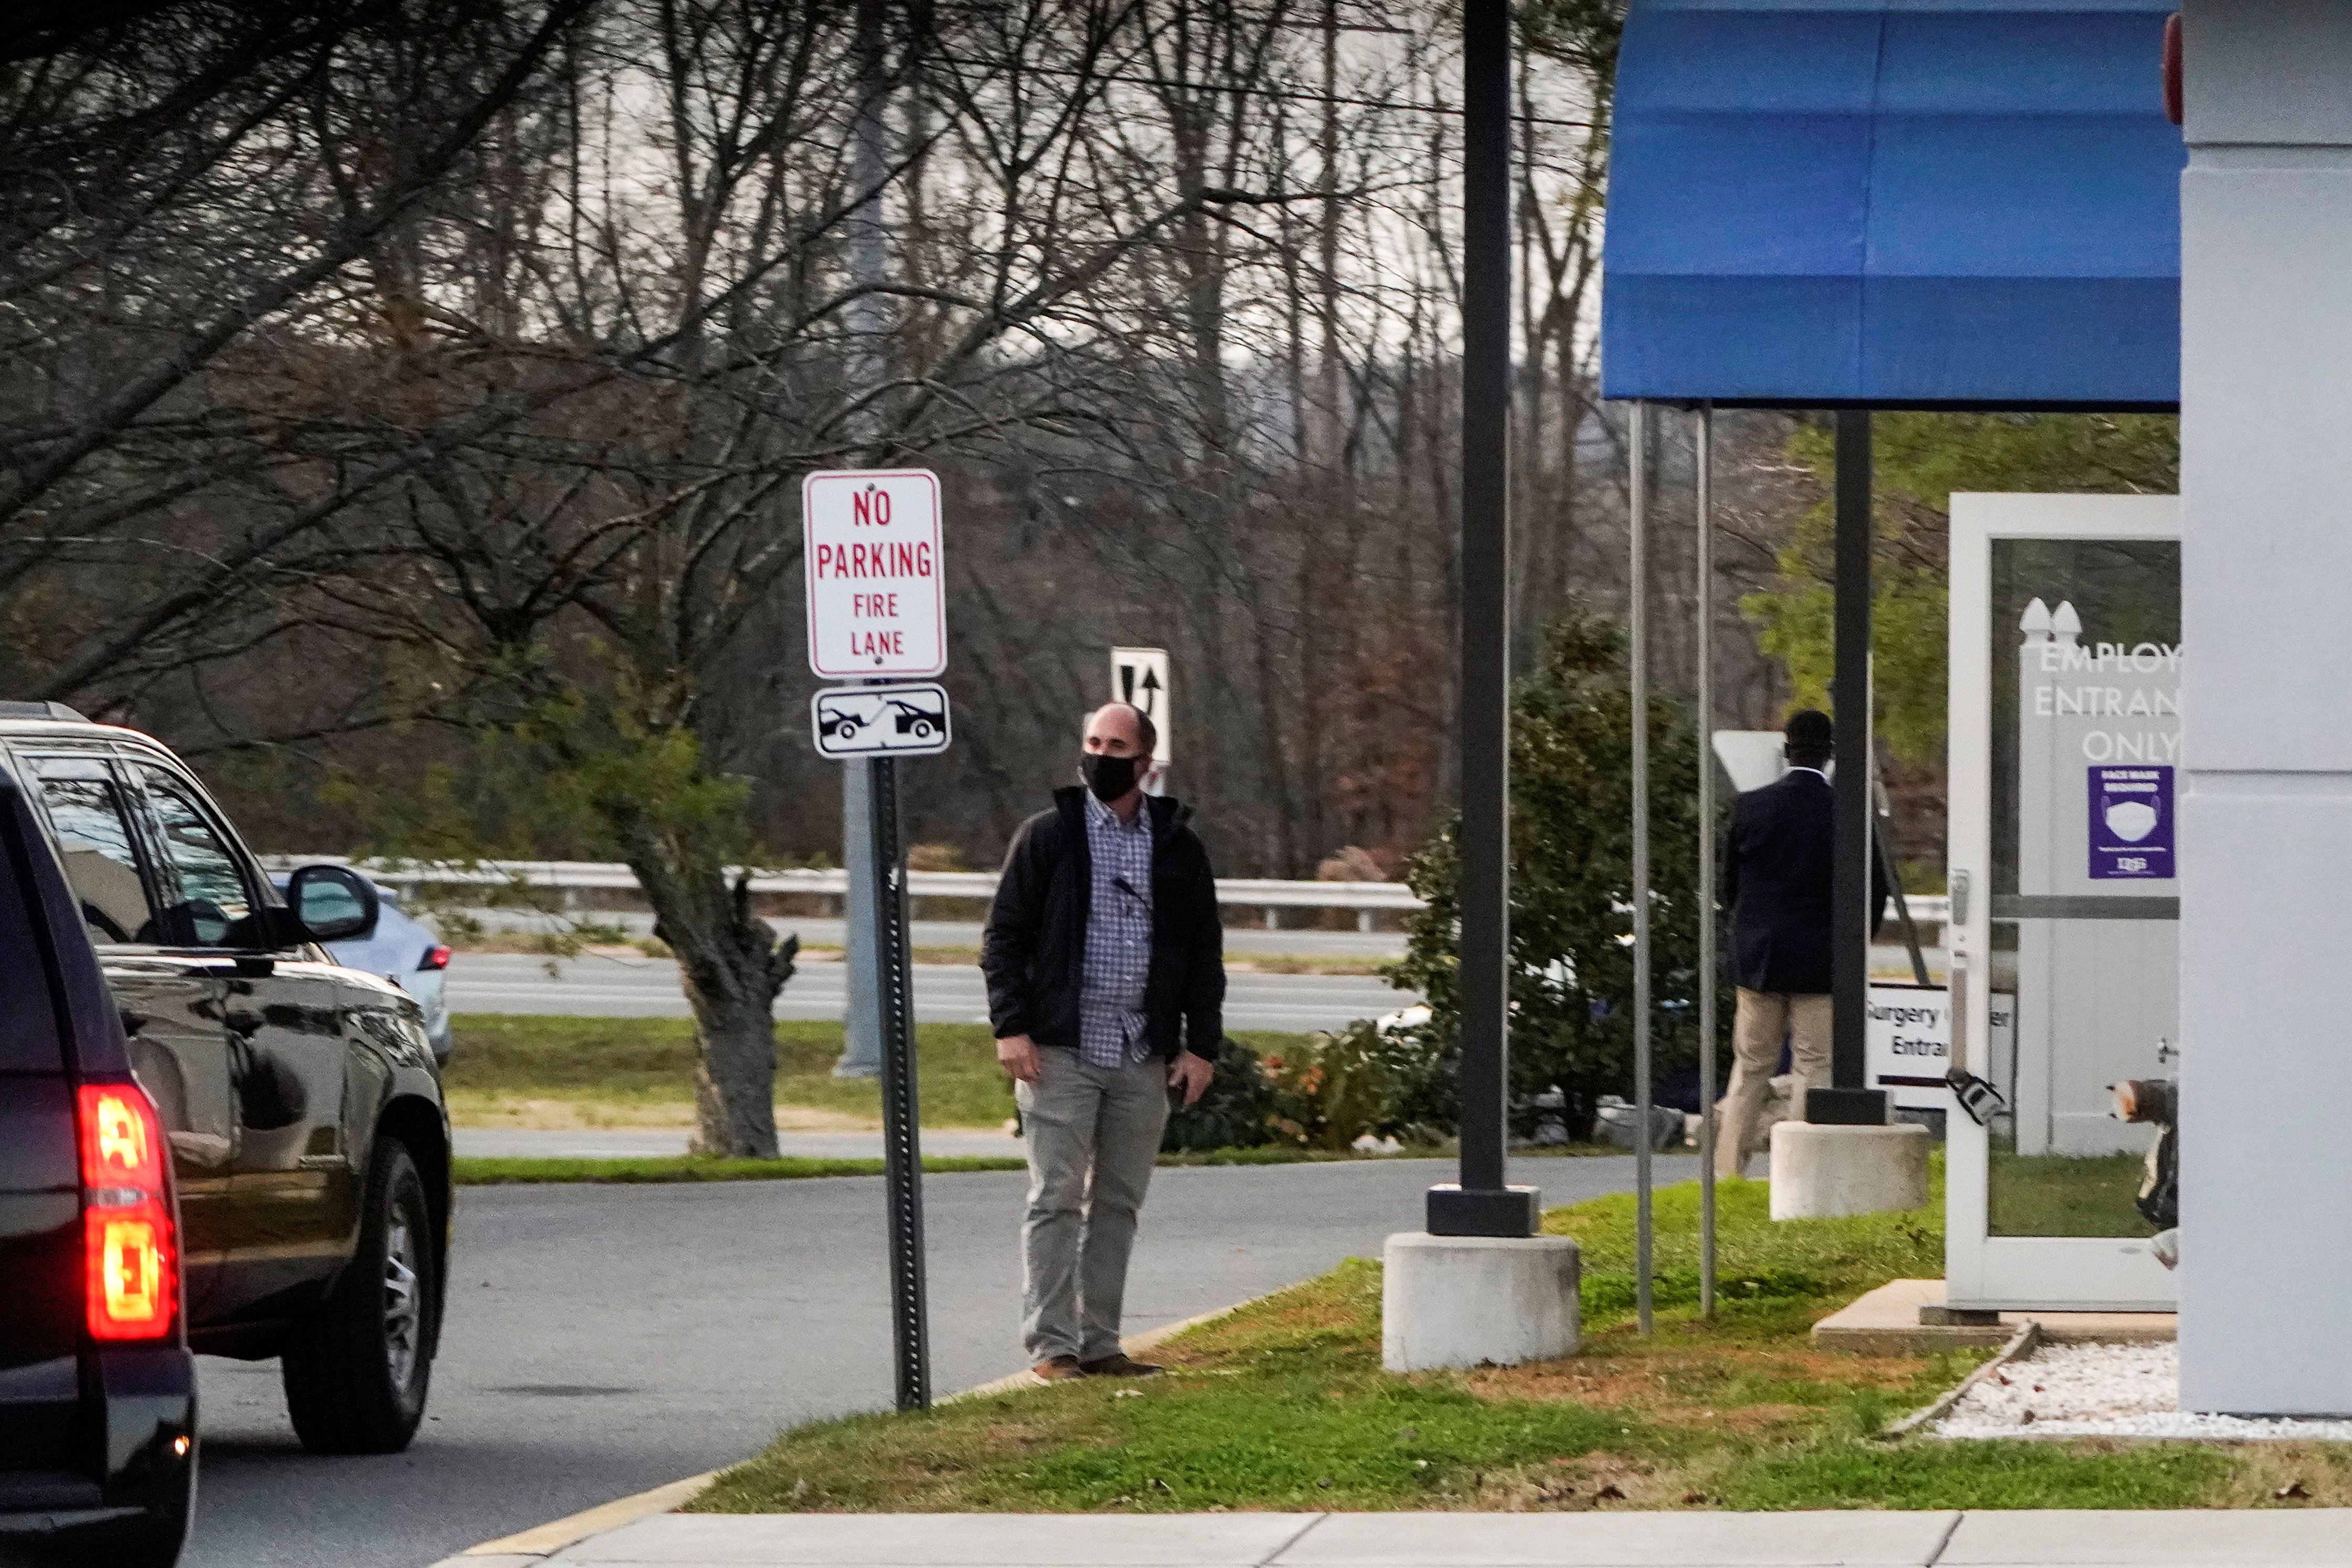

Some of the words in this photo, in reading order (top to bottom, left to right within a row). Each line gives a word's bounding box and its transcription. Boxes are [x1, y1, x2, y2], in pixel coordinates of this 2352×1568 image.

[853, 490, 891, 526] NO
[817, 541, 931, 579] PARKING
[854, 593, 899, 617] FIRE
[851, 631, 904, 656] LANE
[2082, 730, 2179, 762] ONLY
